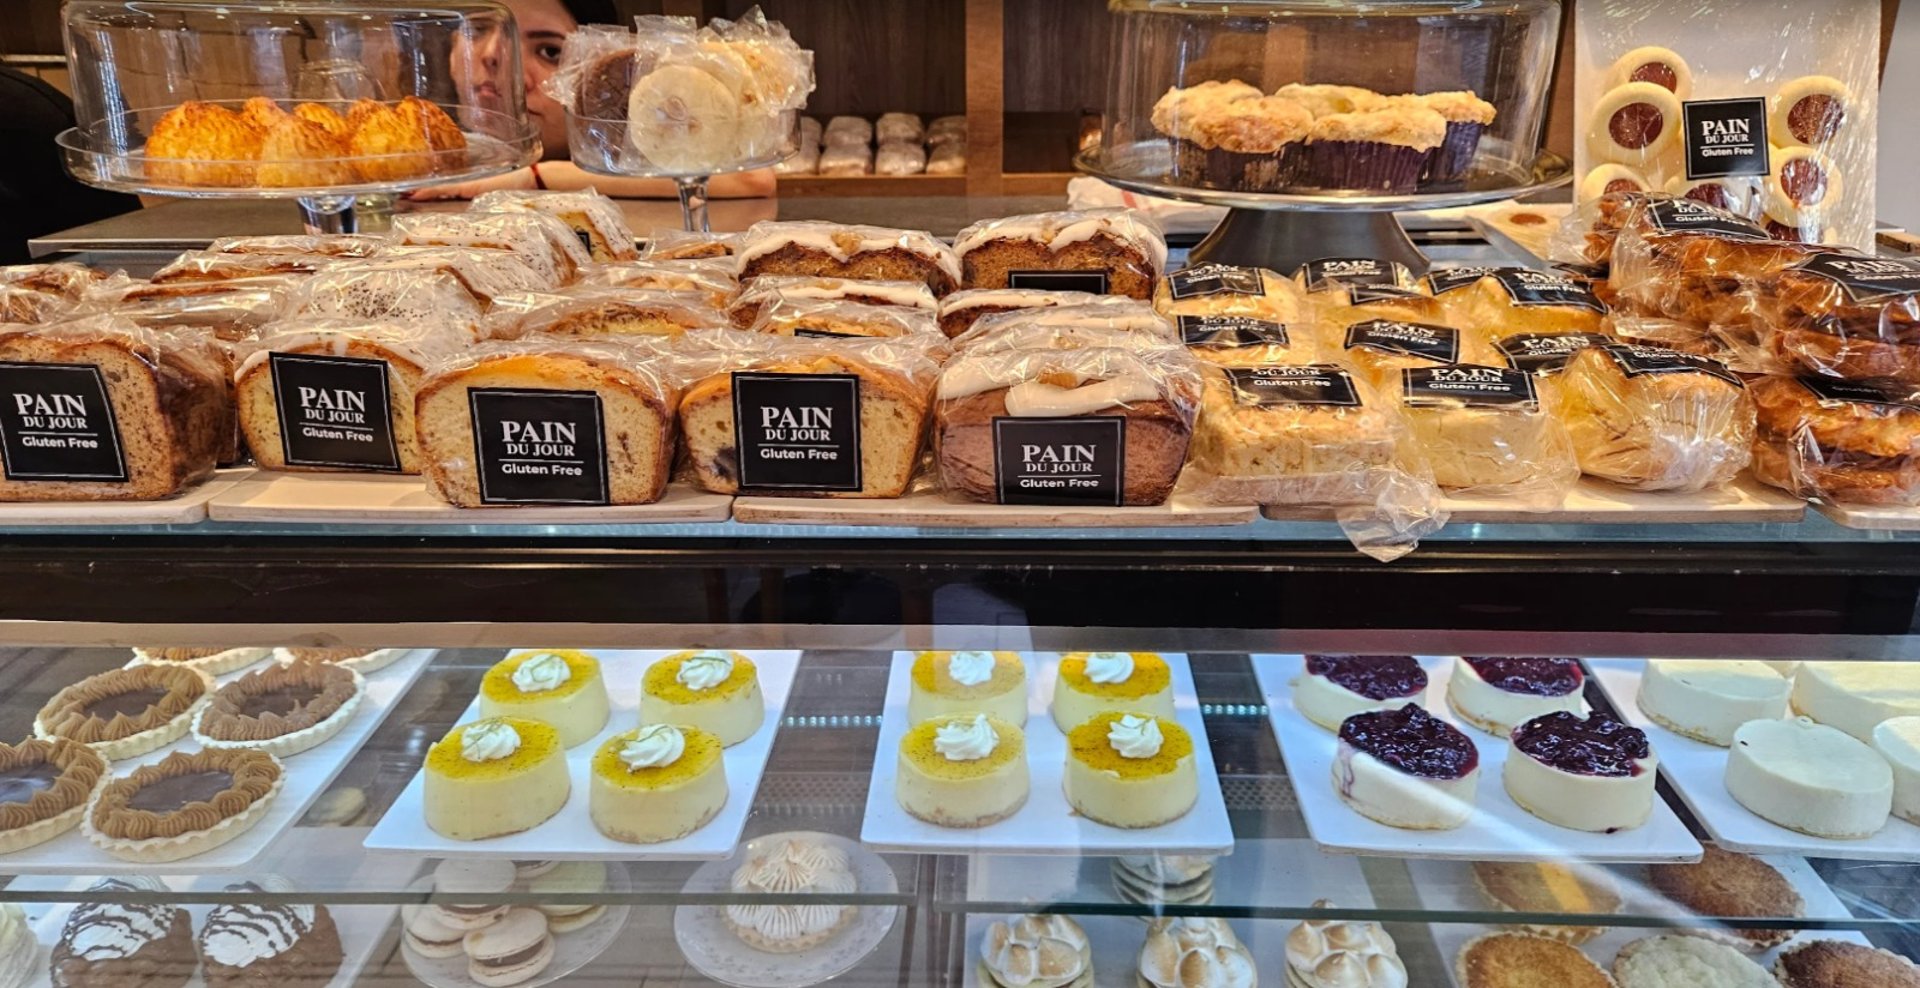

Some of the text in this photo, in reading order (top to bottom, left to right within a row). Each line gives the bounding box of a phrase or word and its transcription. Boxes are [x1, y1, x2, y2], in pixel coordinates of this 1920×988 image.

[1701, 118, 1750, 136] PAIN
[1705, 133, 1749, 144] DU JOUR
[1702, 147, 1753, 157] Gluten Free
[1429, 368, 1503, 378] PAIN
[1460, 374, 1503, 382] JOUR
[1253, 378, 1331, 388] Gluten Free
[1429, 382, 1511, 391] Gluten Free
[12, 393, 87, 417] PAIN
[298, 386, 366, 413] PAIN
[22, 416, 88, 430] DU JOUR
[304, 409, 366, 424] DU JOUR
[760, 406, 834, 429] PAIN
[302, 427, 374, 442] Gluten Free
[500, 420, 577, 444] PAIN
[765, 428, 831, 442] DU JOUR
[22, 436, 98, 449] Gluten Free
[506, 443, 576, 457] DU JOUR
[760, 448, 838, 461] Gluten Free
[1021, 444, 1097, 463] PAIN
[501, 463, 583, 476] Gluten Free
[1025, 462, 1093, 473] DU JOUR
[1019, 479, 1099, 488] Gluten Free
